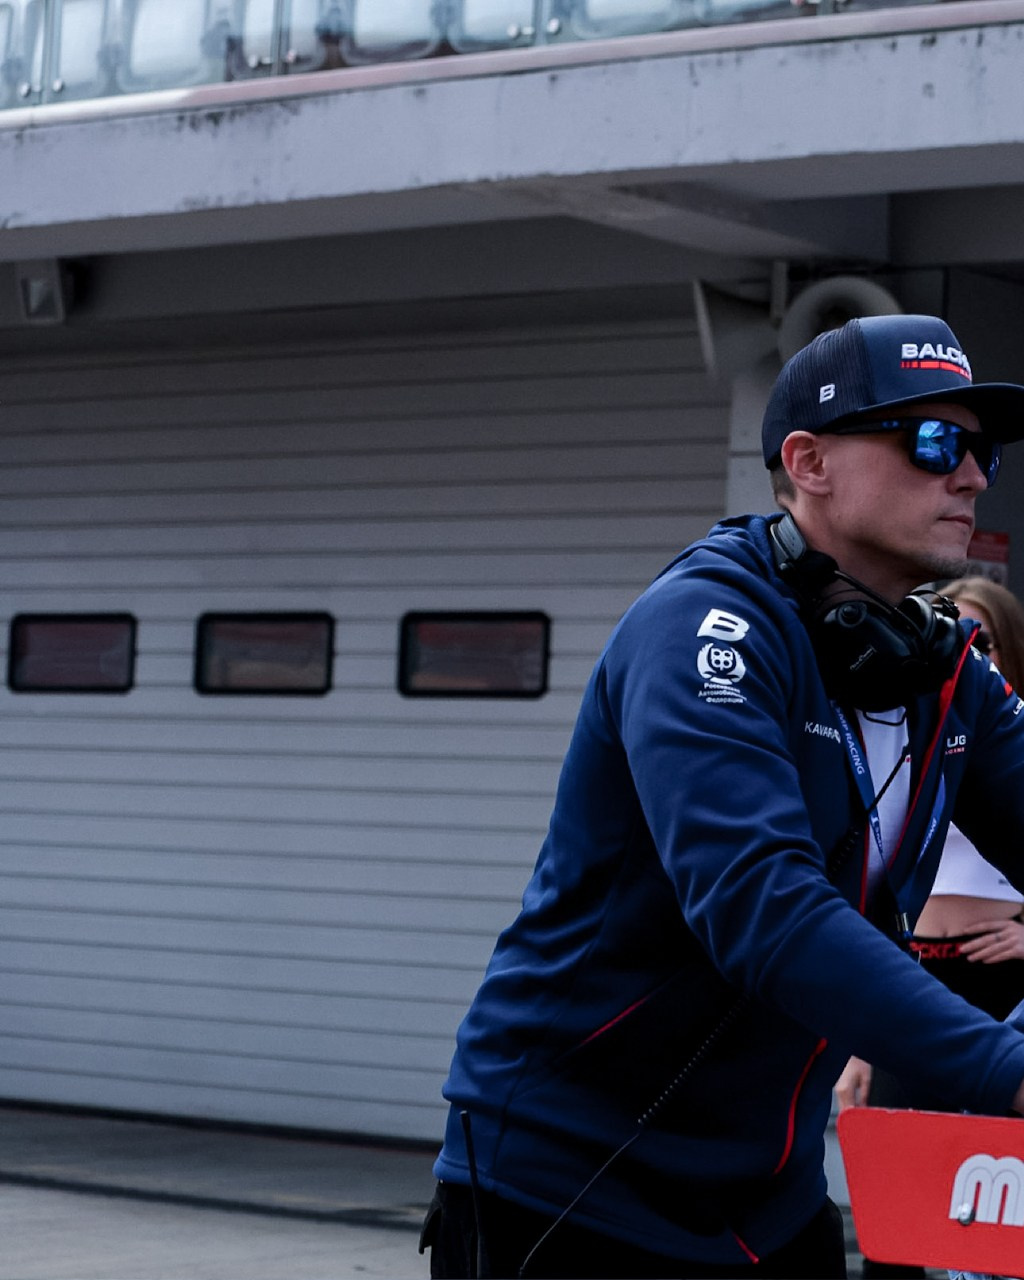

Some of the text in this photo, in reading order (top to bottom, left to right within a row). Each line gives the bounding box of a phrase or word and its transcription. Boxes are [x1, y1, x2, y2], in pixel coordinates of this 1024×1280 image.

[819, 383, 836, 404] B
[697, 608, 750, 642] B
[844, 732, 866, 776] RACING
